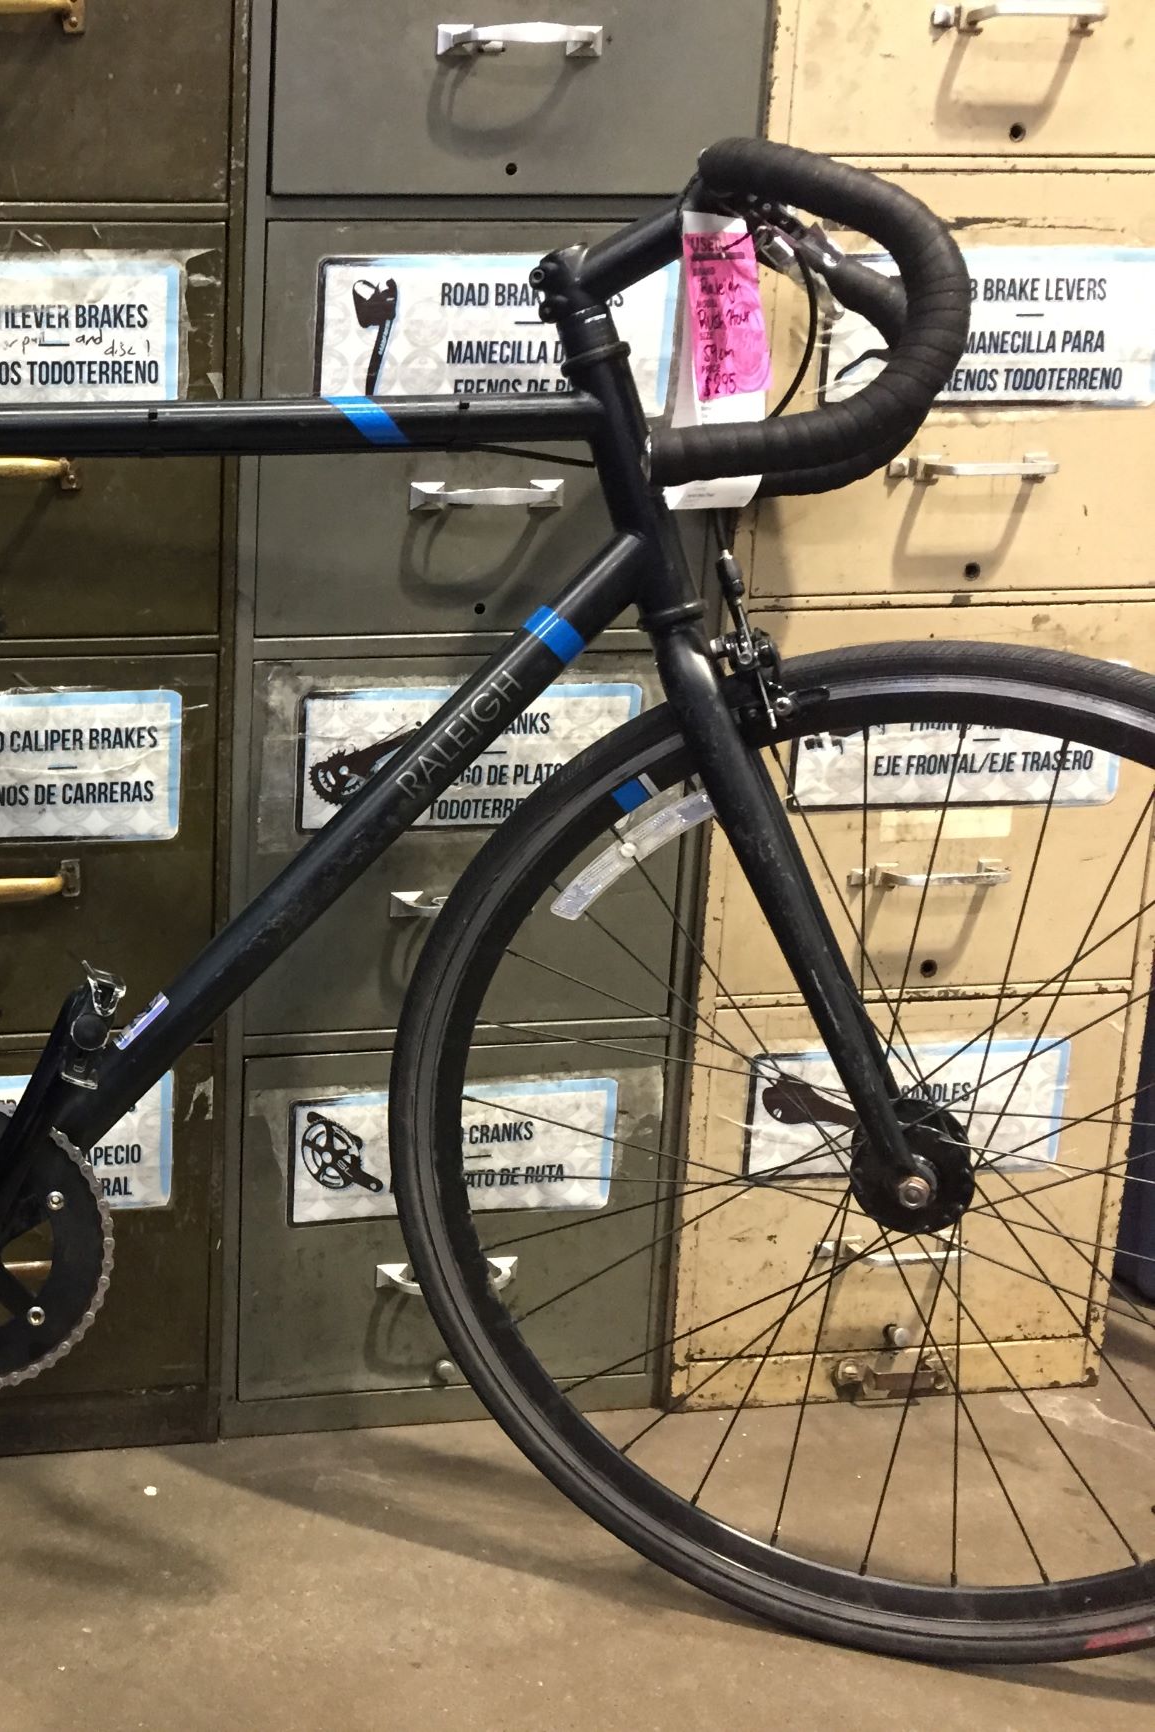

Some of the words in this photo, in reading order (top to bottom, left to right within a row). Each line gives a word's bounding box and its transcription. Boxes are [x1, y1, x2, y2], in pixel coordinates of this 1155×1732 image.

[441, 282, 489, 306] ROAD
[495, 282, 542, 306] BRAK
[983, 278, 1040, 302] BRAKE
[1045, 278, 1107, 301] LEVERS
[75, 303, 149, 329] BRAKES
[75, 329, 103, 345] and
[104, 339, 136, 356] disc
[446, 341, 548, 365] MANECILLA
[554, 341, 567, 364] D
[1061, 330, 1105, 353] PARA
[27, 360, 159, 386] TODOTERRENO
[1004, 368, 1122, 392] TODOTERRENO
[396, 669, 524, 801] RALEIGH
[502, 712, 550, 734] ANKS
[10, 728, 84, 753] CALIPER
[89, 725, 158, 750] BRAKES
[486, 764, 509, 786] DE
[874, 755, 900, 777] EJE
[906, 751, 1015, 776] FRONTAL/EJE
[1022, 750, 1094, 773] TRASERO
[34, 784, 56, 806] DE
[62, 780, 155, 805] CARRERAS
[429, 798, 527, 820] TODOTERR
[469, 1120, 534, 1145] CRANKS
[93, 1143, 142, 1166] PECIO
[465, 1168, 495, 1188] ATO
[499, 1167, 521, 1187] DE
[525, 1163, 565, 1185] RUTA
